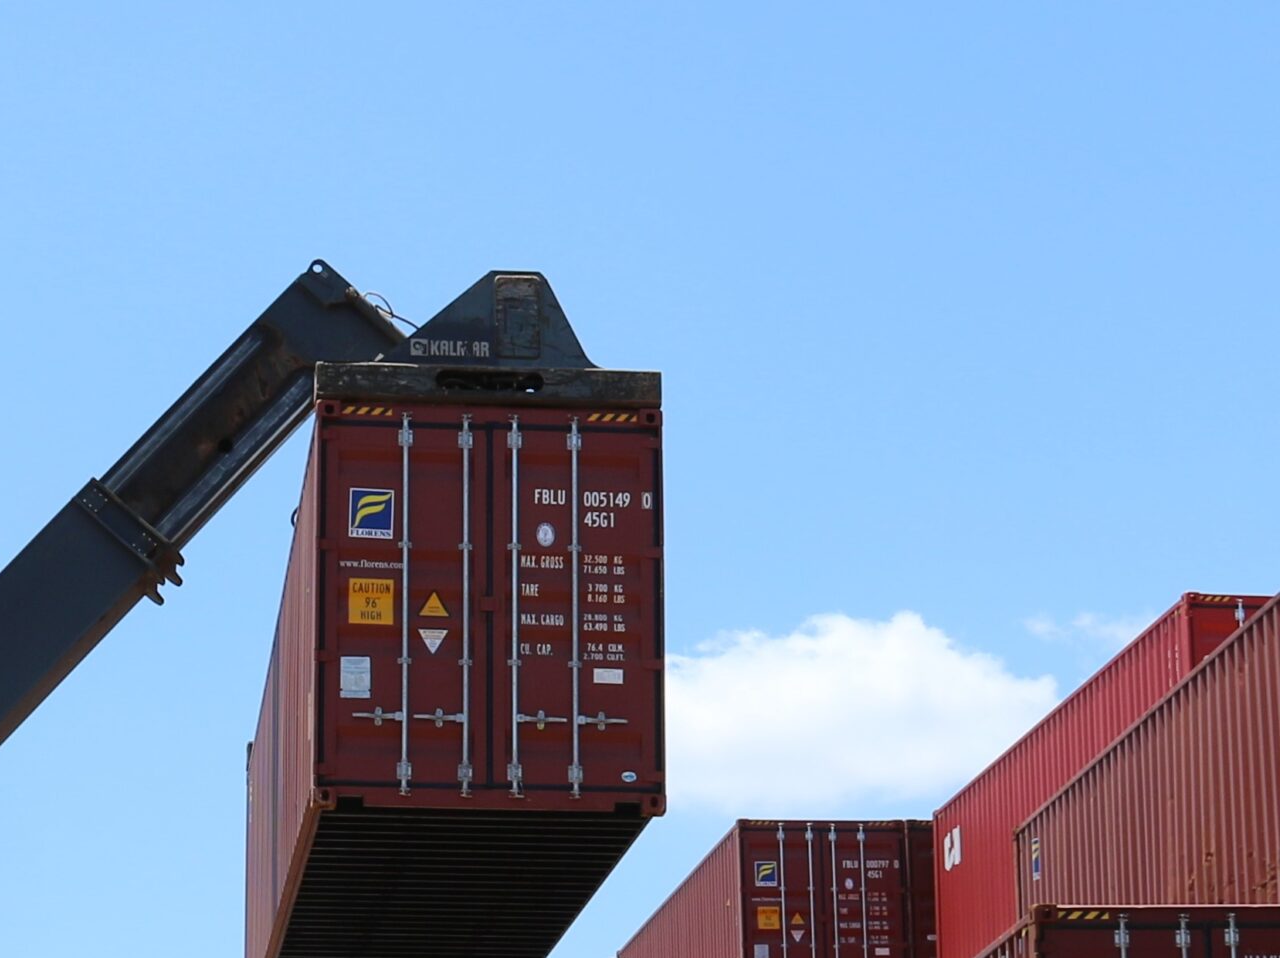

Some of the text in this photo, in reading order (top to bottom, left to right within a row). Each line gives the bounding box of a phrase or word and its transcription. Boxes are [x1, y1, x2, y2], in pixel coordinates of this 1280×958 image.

[534, 488, 651, 509] FBLU 005149 0
[584, 512, 615, 528] 45G1
[350, 529, 391, 537] FLORENS
[521, 555, 539, 568] MAX.
[541, 556, 564, 569] GROSS
[614, 556, 623, 564] KG
[613, 566, 625, 575] LBS
[352, 582, 391, 594] CAUTION
[521, 584, 539, 596] TARE
[614, 584, 623, 593] KG
[614, 595, 625, 603] LBS
[360, 610, 382, 620] HIGH
[541, 614, 564, 626] CARGO
[614, 623, 626, 632] LBS
